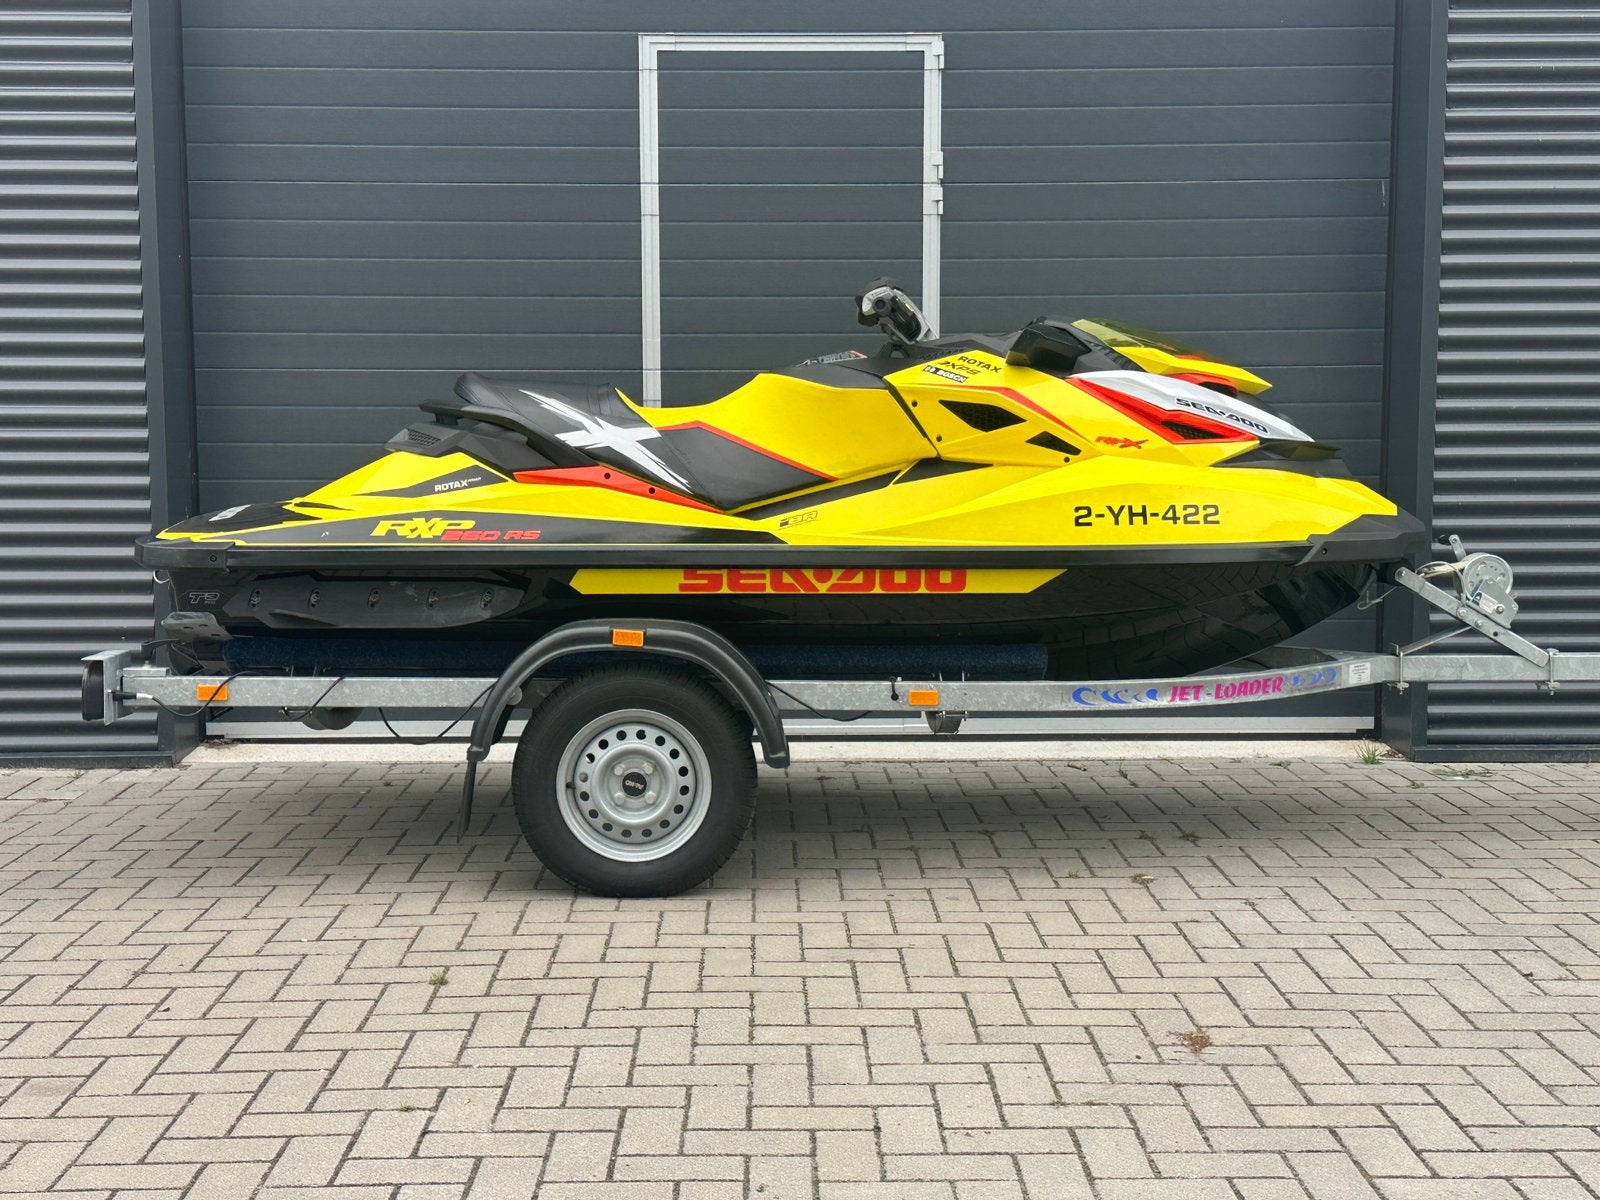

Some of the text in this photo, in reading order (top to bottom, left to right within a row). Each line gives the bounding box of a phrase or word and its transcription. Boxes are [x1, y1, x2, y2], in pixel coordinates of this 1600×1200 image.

[958, 356, 1002, 373] ROTAX
[434, 479, 468, 492] ROTAX
[1074, 504, 1220, 527] 2-YH-422
[370, 517, 476, 539] RXP
[503, 530, 541, 540] RS
